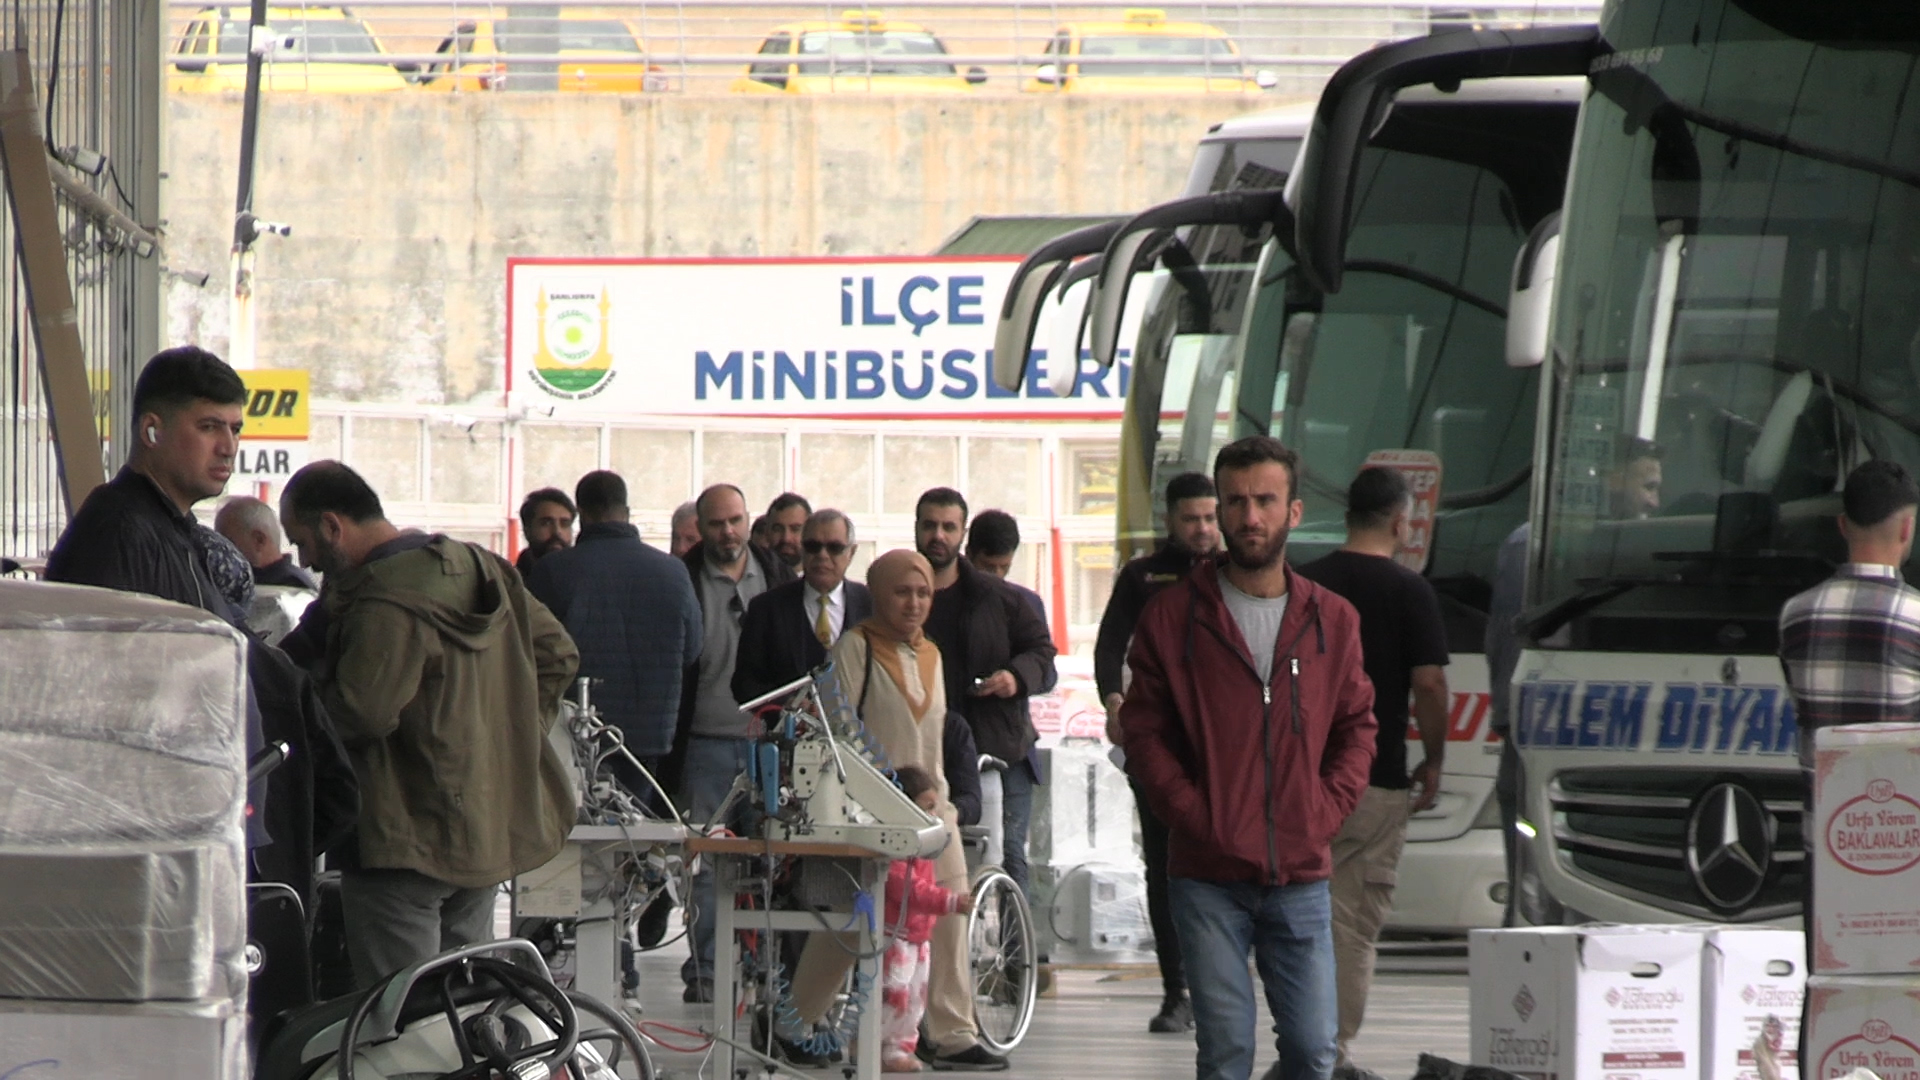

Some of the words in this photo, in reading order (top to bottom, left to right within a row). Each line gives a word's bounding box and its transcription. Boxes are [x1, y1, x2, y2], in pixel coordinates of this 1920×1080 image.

[841, 275, 984, 336] İLÇE
[247, 389, 299, 418] OR
[238, 449, 290, 474] LAR
[1845, 811, 1874, 831] Urfa
[1876, 809, 1916, 827] Yörem
[1838, 1051, 1870, 1068] Urfa
[1872, 1050, 1915, 1068] Yörem
